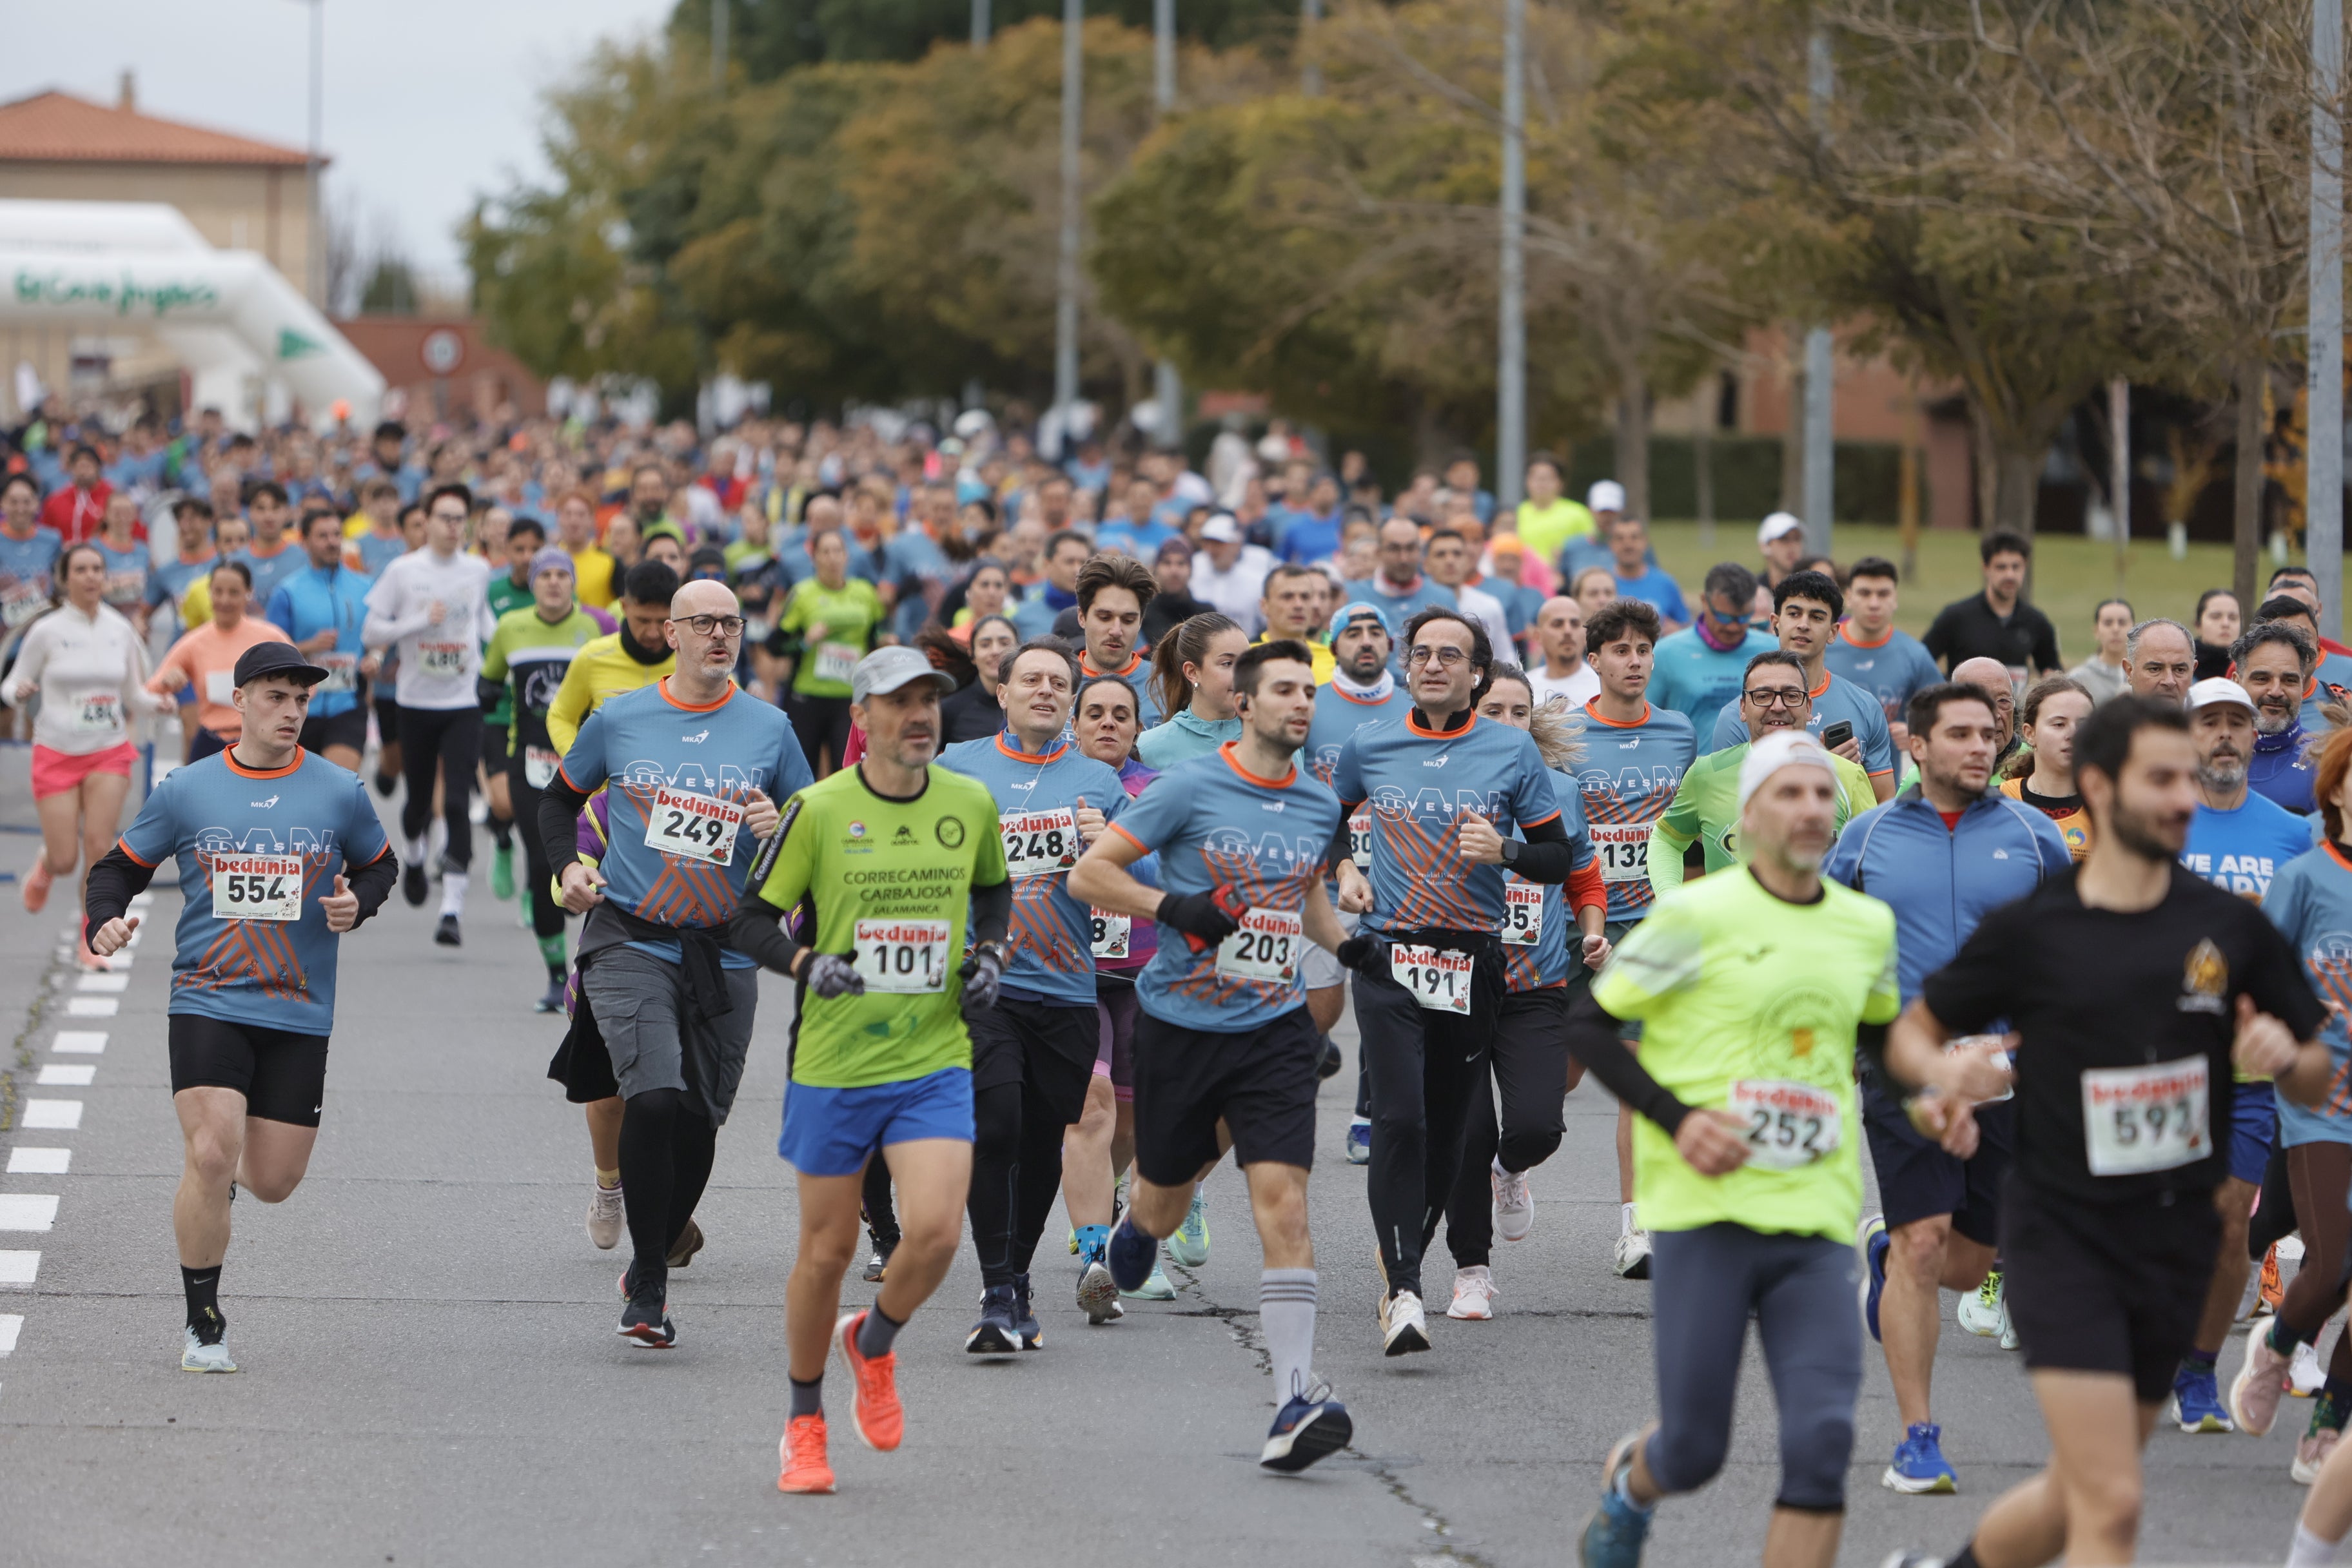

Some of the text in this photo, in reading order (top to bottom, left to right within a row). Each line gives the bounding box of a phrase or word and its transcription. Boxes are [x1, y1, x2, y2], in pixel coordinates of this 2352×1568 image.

[623, 760, 763, 805] SAN
[1577, 765, 1682, 802] SAN
[1586, 778, 1681, 791] ILVESTR
[656, 790, 740, 824] bedunia
[1374, 785, 1500, 826] SAN
[663, 810, 723, 847] 249
[194, 841, 331, 854] SILVESTRE
[195, 827, 334, 867] SAN
[1006, 830, 1064, 863] 248
[1206, 826, 1326, 877] SAN
[1603, 843, 1648, 868] 132
[215, 858, 300, 876] bedunia
[681, 861, 716, 870] Salamanca
[843, 867, 965, 885] CORRECAMINOS
[2219, 854, 2274, 878] ARE
[228, 875, 286, 904] 554
[859, 885, 953, 902] CARBAJOSA
[1505, 888, 1542, 905] unia
[874, 904, 939, 915] SALAMANCA
[1240, 915, 1300, 936] edunia
[874, 945, 930, 975] 101
[1235, 932, 1289, 965] 203
[1395, 948, 1471, 972] bedunia
[1407, 967, 1454, 997] 191
[1749, 1110, 1823, 1149] 252
